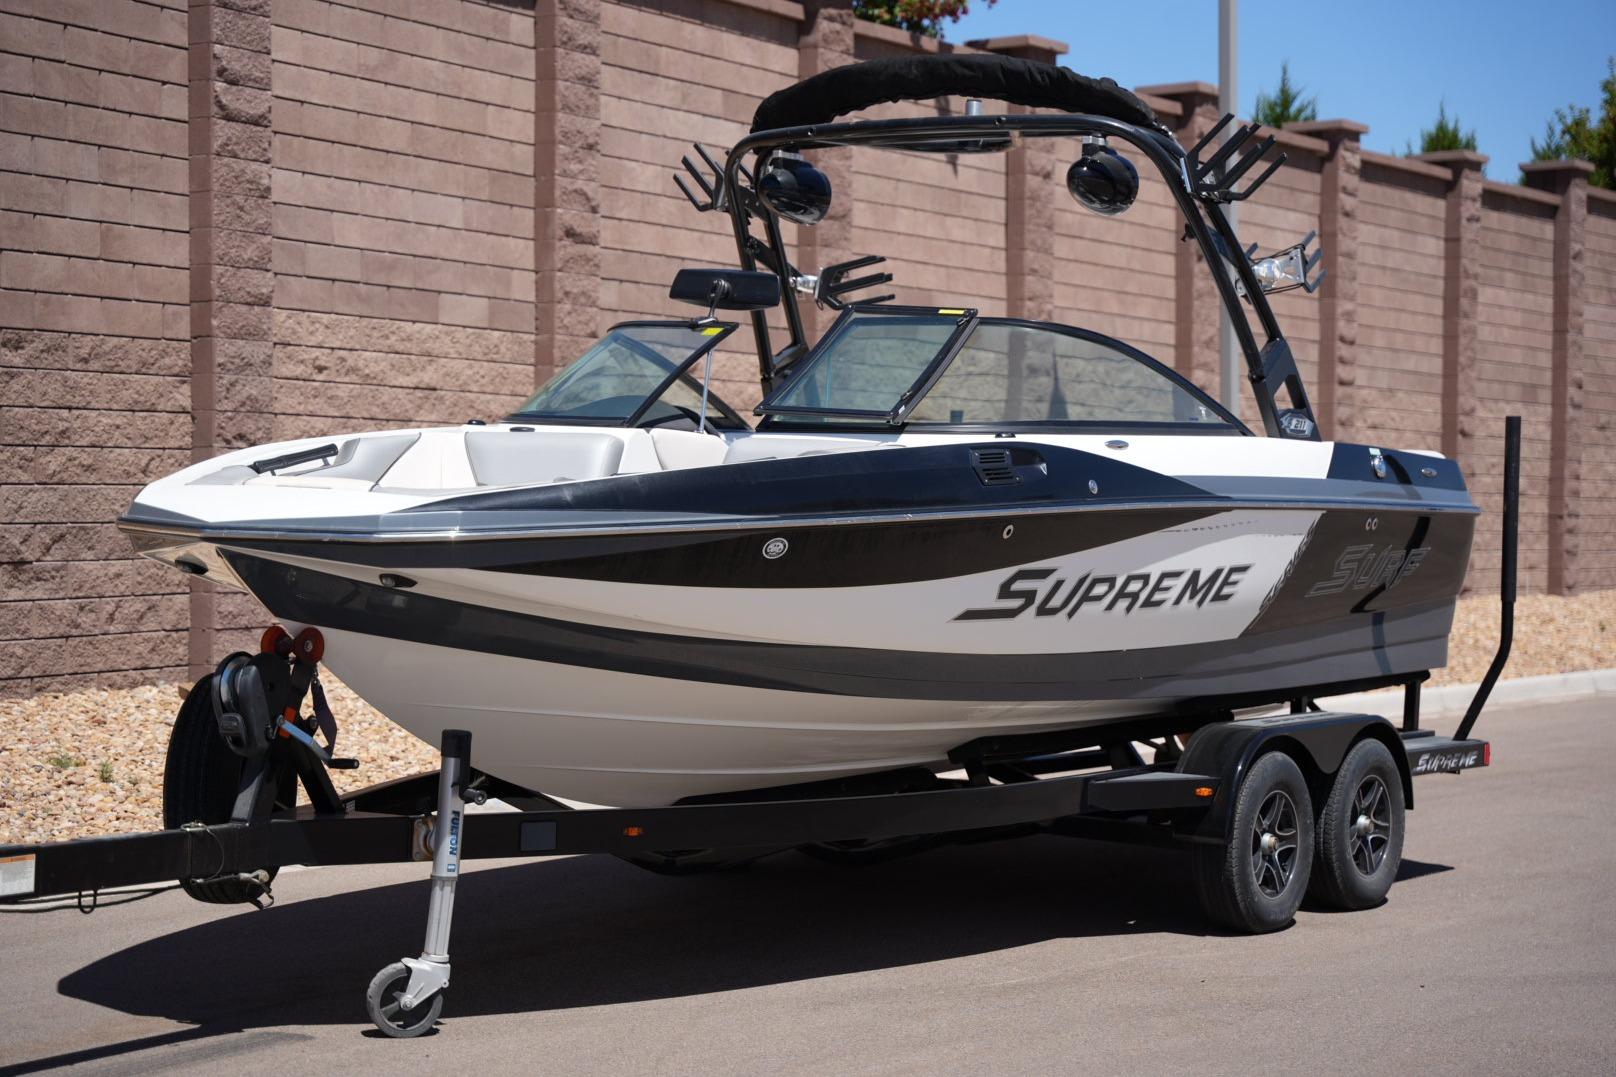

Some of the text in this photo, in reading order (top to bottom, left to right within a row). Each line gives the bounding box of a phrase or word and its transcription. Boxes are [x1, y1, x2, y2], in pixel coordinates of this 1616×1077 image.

[948, 563, 1254, 622] SUPREME
[1304, 544, 1431, 597] SURF
[1413, 751, 1479, 772] SUPREME
[449, 810, 460, 855] FULTON
